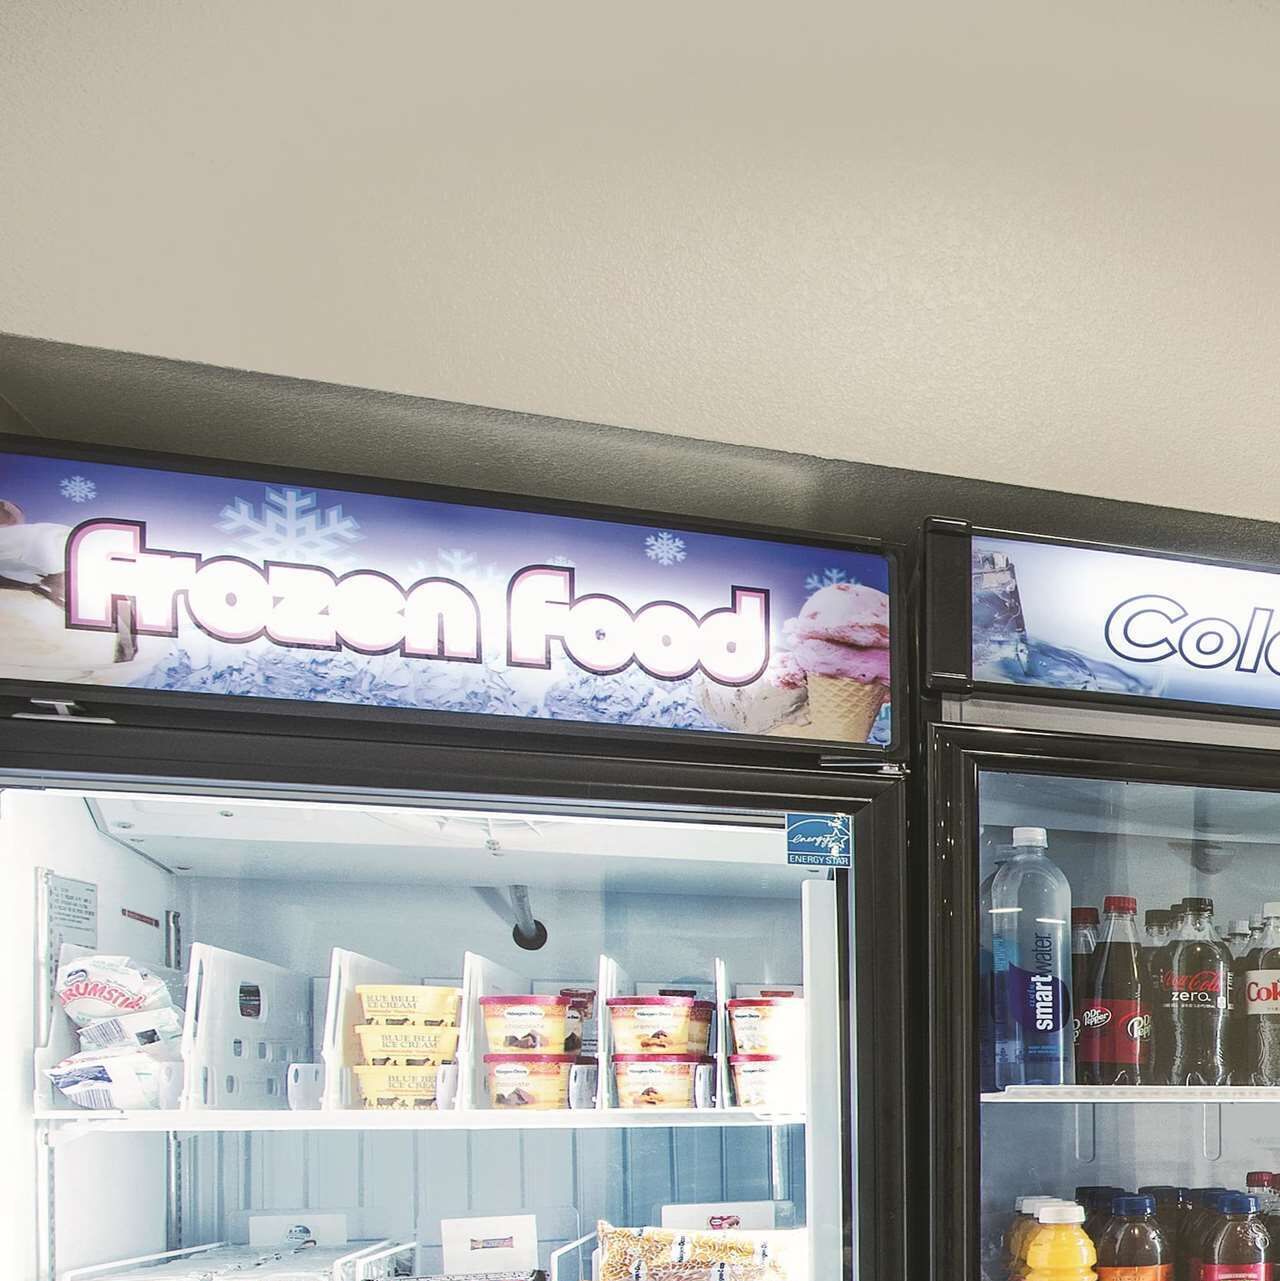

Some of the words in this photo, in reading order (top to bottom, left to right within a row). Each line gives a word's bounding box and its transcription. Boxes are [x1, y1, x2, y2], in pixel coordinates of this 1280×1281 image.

[65, 519, 481, 662] frozen
[507, 565, 770, 686] food
[790, 855, 825, 863] ENERGY
[826, 856, 848, 864] STAR
[1171, 990, 1211, 1002] zero
[388, 1076, 416, 1084] BLUE
